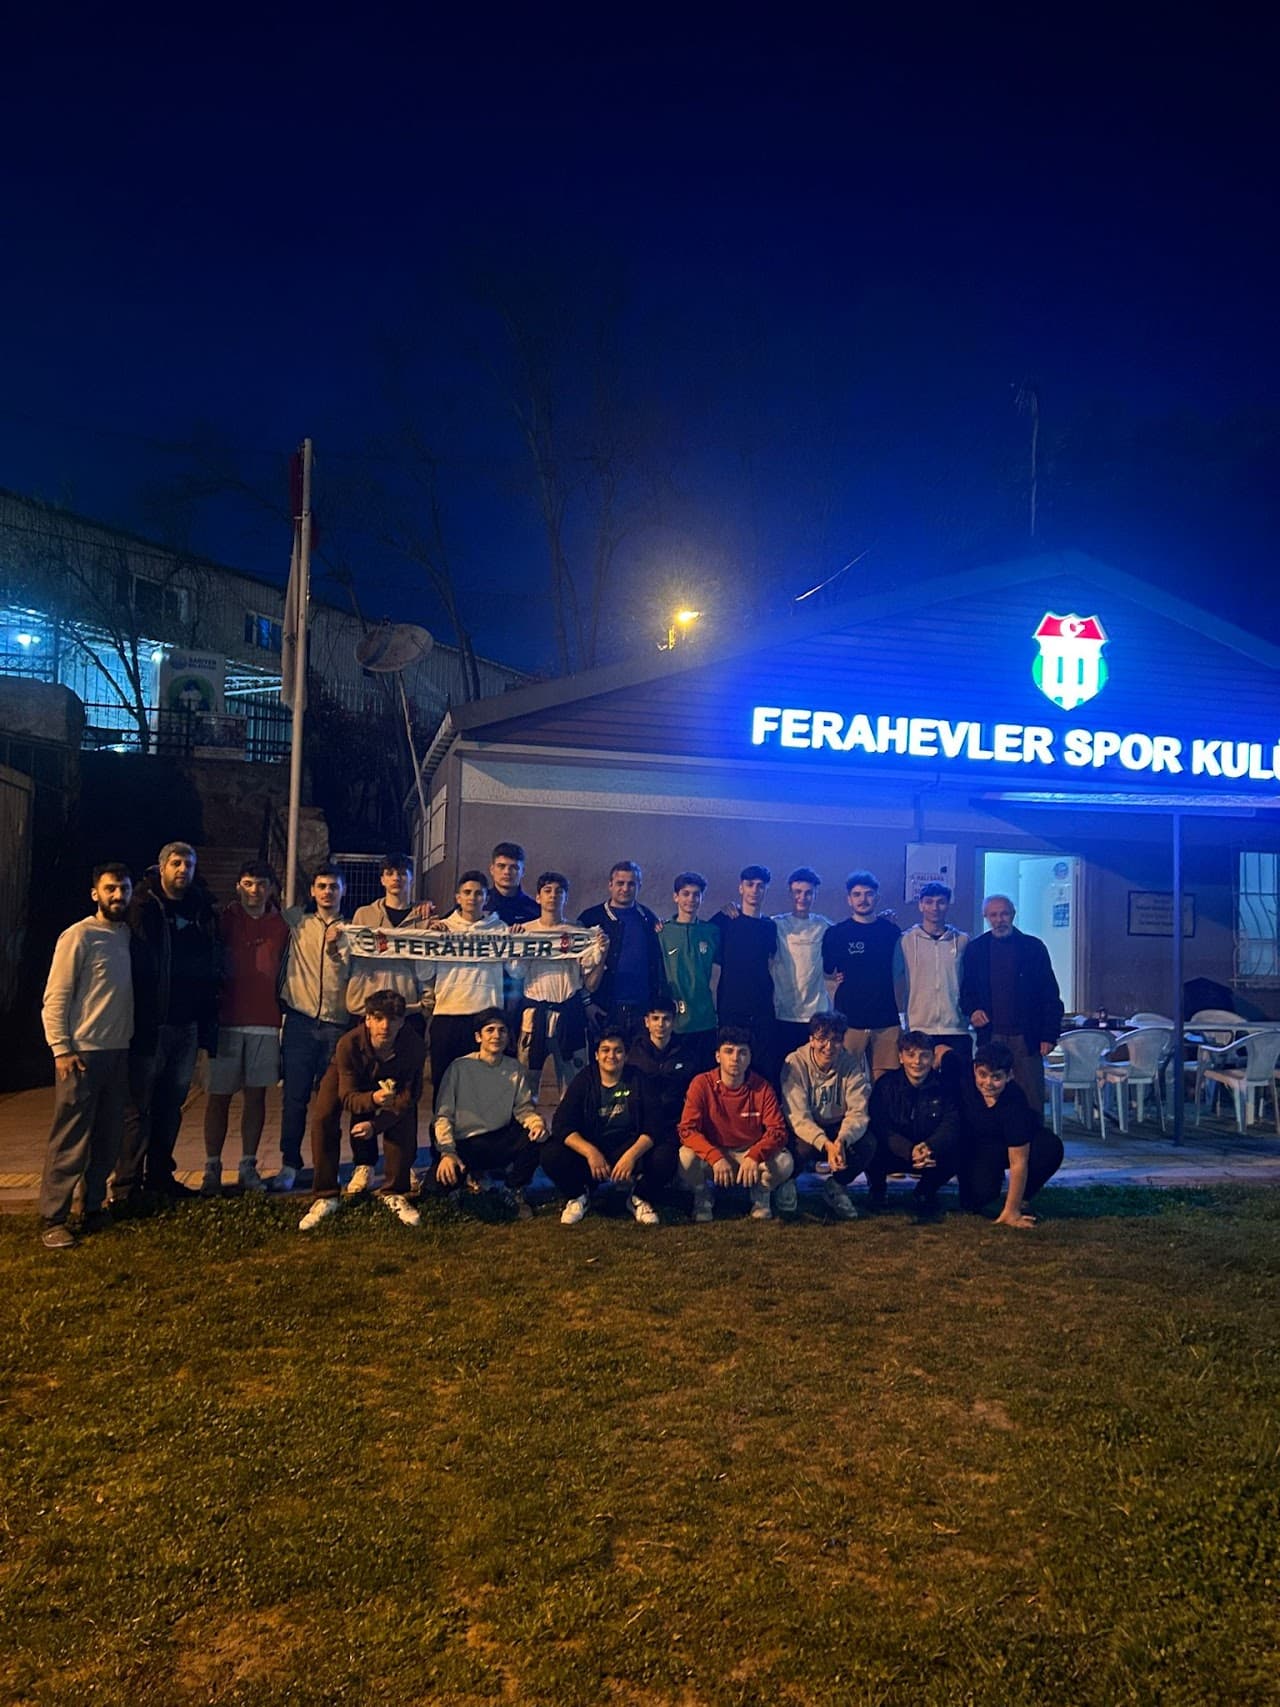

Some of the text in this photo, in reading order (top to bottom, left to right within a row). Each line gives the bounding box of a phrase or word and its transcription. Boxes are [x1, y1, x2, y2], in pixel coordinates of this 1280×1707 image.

[752, 706, 1280, 781] FERAHEVLER SPOR KUL
[394, 938, 553, 958] FERAHEVLER
